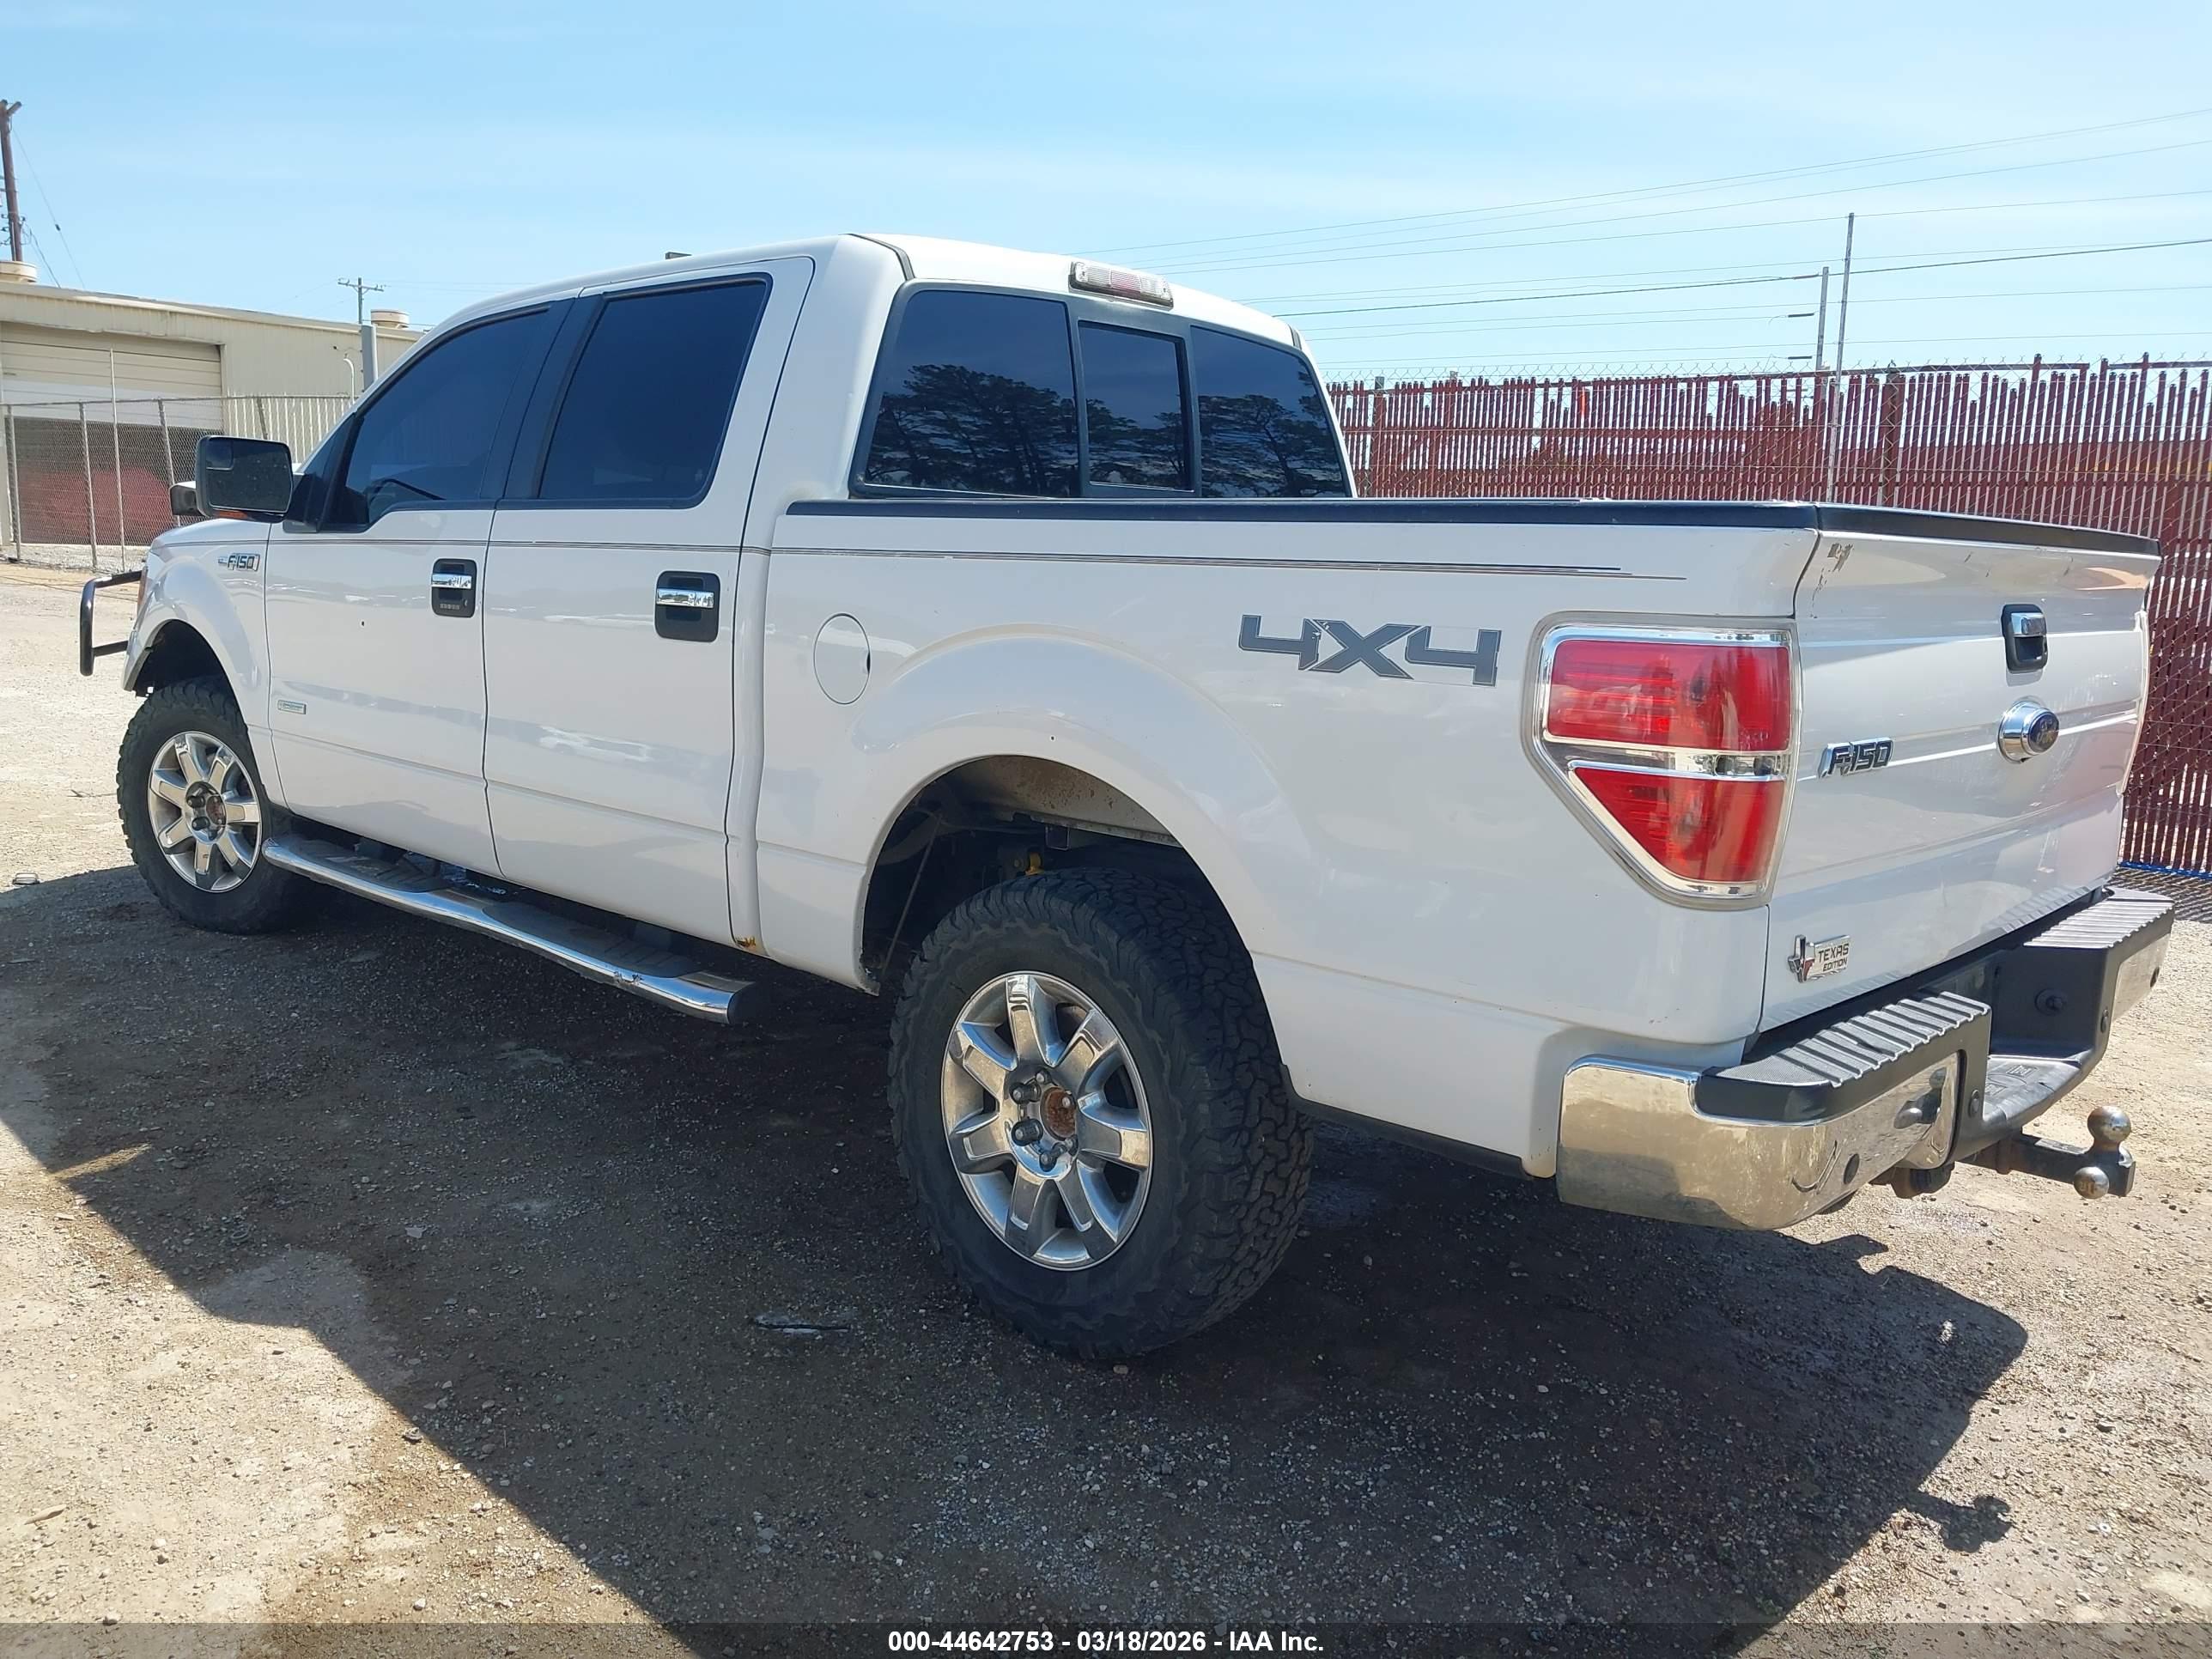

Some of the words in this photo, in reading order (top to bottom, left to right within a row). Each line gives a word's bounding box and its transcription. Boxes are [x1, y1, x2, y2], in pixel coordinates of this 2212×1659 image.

[1238, 614, 1503, 687] 4X4
[1818, 943, 1850, 963] TEXAS
[1822, 957, 1848, 972] EDITION
